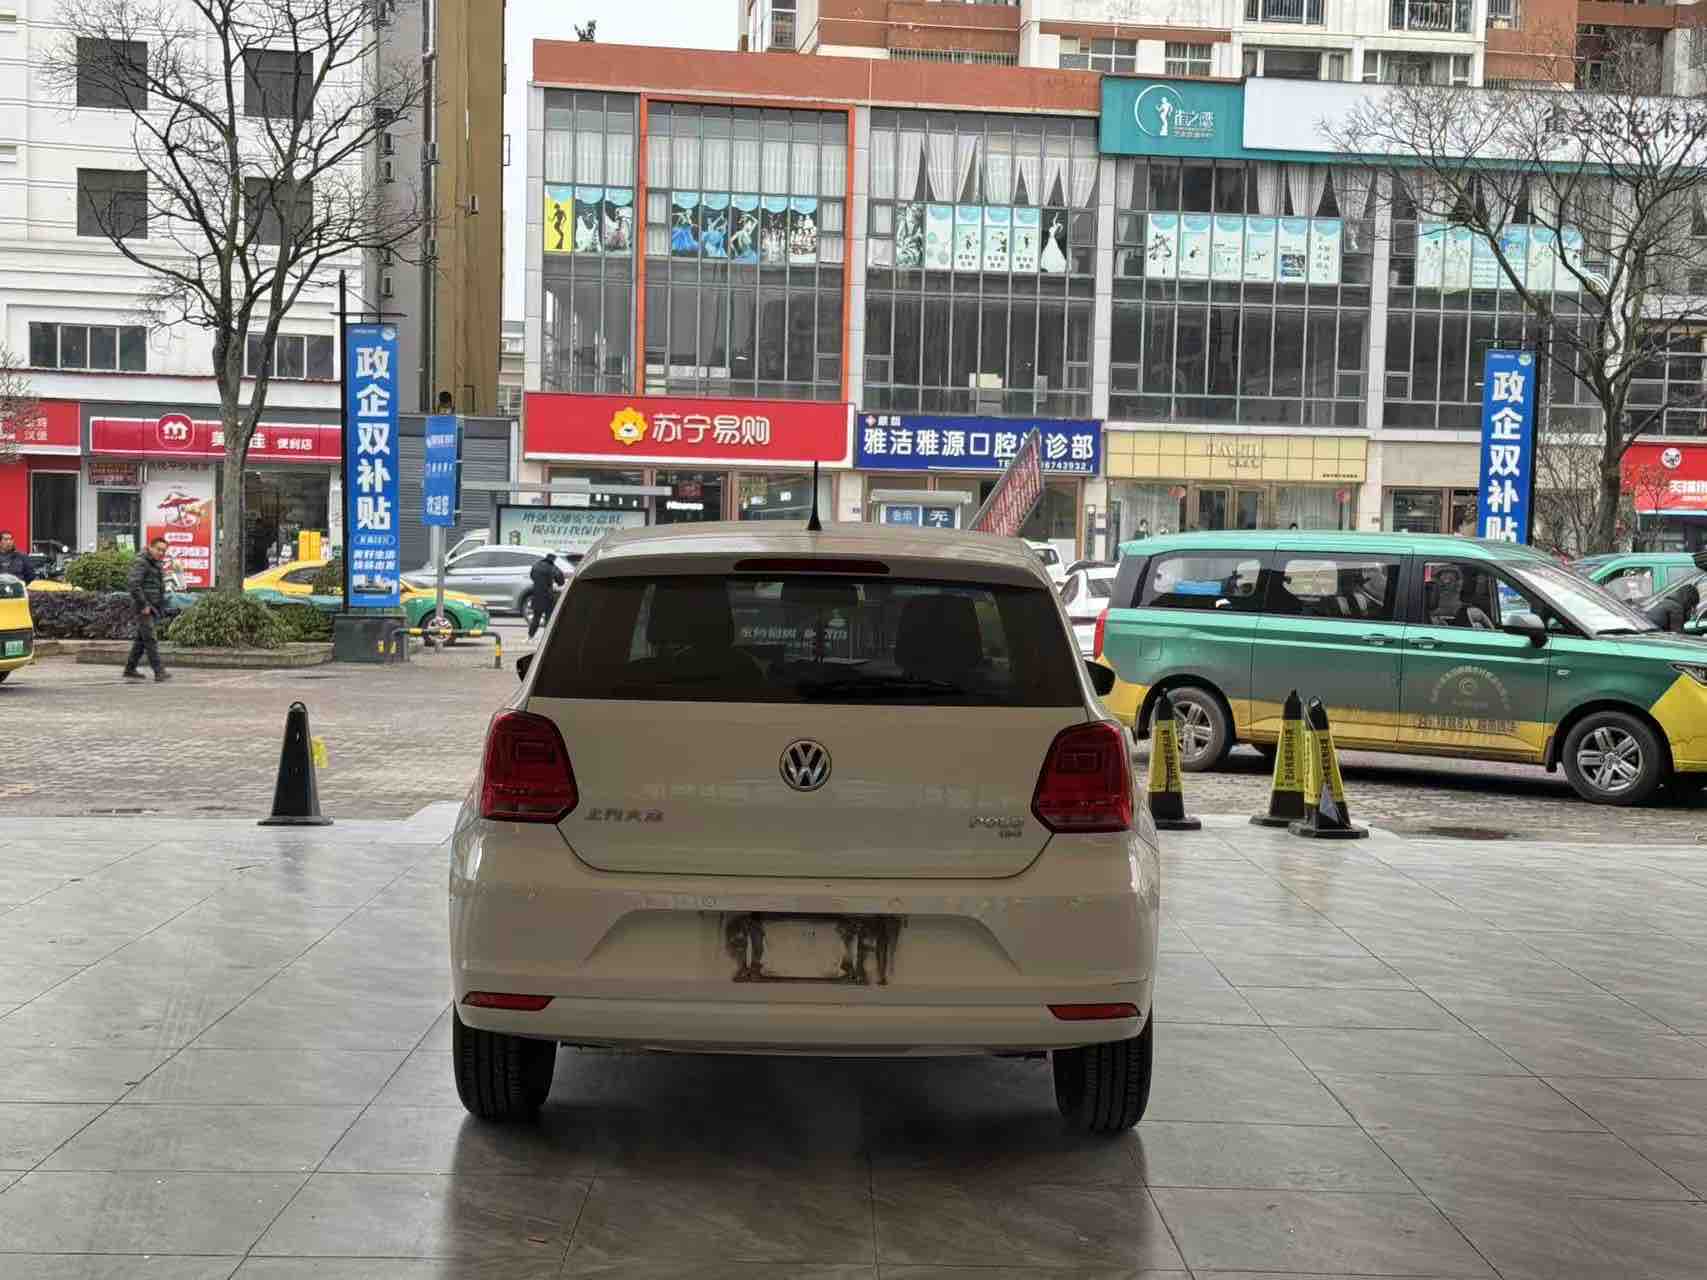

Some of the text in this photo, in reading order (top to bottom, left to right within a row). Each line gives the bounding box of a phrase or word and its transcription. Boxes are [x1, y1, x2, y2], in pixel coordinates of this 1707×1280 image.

[355, 345, 392, 531] 政企双补贴
[651, 412, 771, 446] 苏宁易购
[1486, 370, 1525, 544] 政企双补贴
